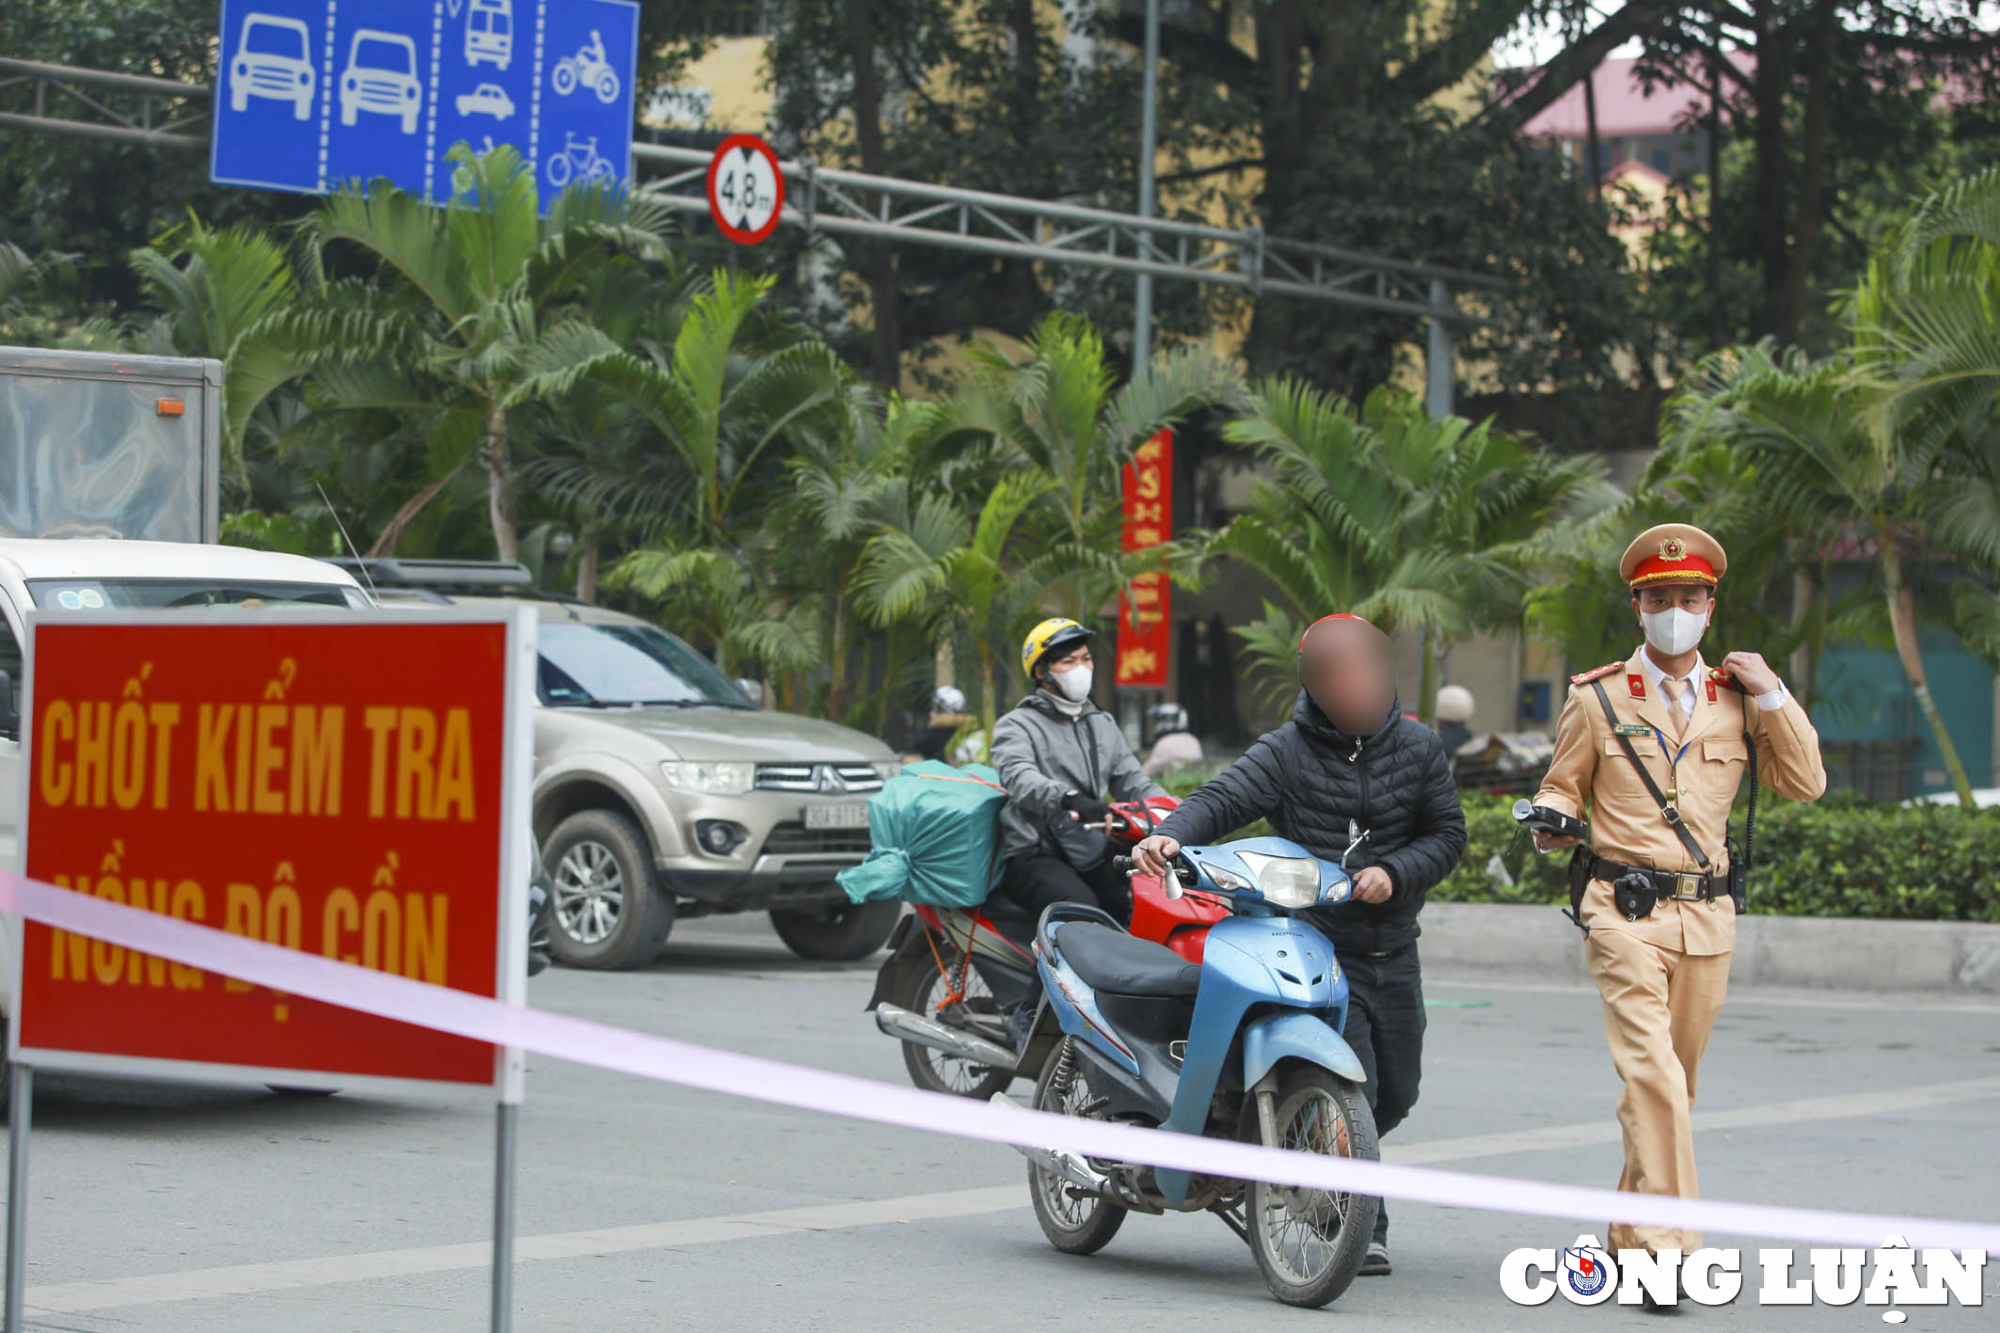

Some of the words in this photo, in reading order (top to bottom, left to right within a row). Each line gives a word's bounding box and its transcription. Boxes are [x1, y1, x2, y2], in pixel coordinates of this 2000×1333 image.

[40, 662, 181, 810] CHỐT
[194, 658, 346, 816] KIỂM
[364, 707, 477, 821] TRA
[50, 839, 207, 991] NỒNG
[224, 861, 303, 1022] ĐỘ
[322, 851, 450, 993] CỒN
